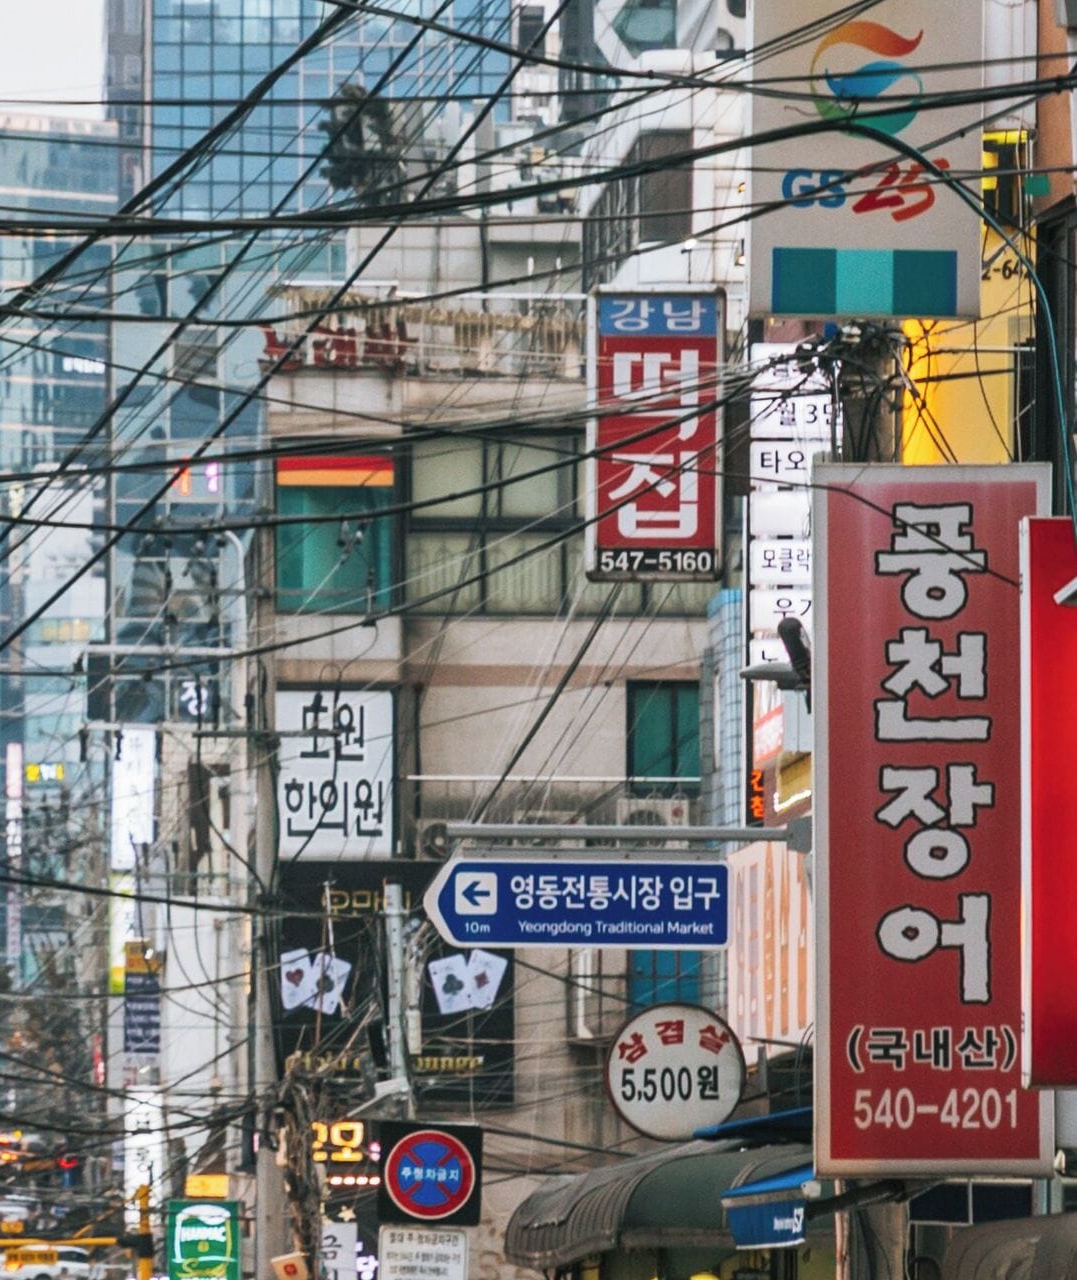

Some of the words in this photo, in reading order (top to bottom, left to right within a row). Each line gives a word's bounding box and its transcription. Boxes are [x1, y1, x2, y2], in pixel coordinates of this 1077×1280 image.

[782, 158, 950, 223] GS25
[609, 299, 706, 332] 강남
[608, 349, 700, 540] 떡집
[600, 551, 712, 572] 547-5160
[299, 703, 364, 762] 도원
[874, 503, 996, 1006] 풍천장어
[284, 778, 383, 837] 한의원
[510, 874, 664, 910] 영동전통시장
[670, 876, 721, 911] 입구
[465, 922, 491, 934] 10m
[518, 920, 592, 936] Yeongdong
[596, 921, 665, 935] Traditional
[667, 922, 714, 935] Market
[617, 1019, 731, 1065] 삼겹살
[847, 1027, 1016, 1072] (국내산)
[621, 1065, 720, 1102] 5,500원
[853, 1088, 1020, 1130] 540-4201
[401, 1166, 460, 1182] 주정차금지
